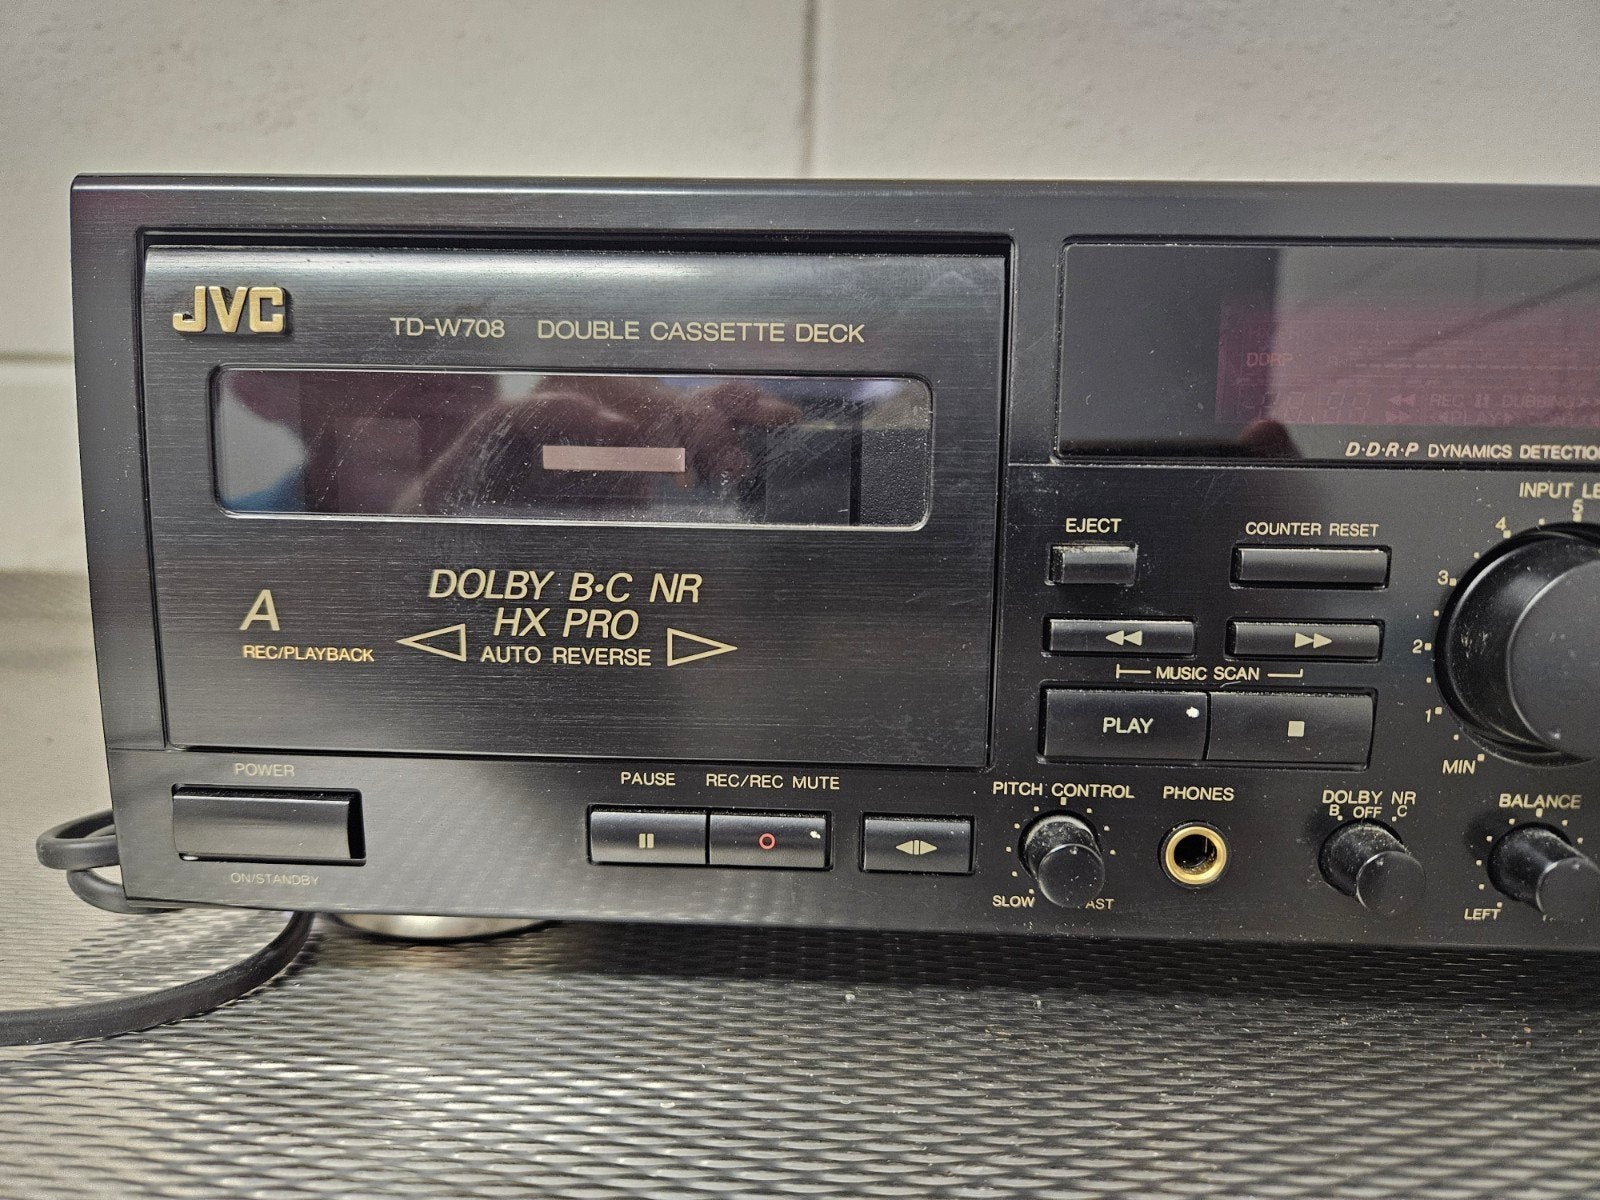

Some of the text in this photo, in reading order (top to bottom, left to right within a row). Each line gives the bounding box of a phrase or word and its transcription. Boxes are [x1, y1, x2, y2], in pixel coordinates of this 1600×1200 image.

[172, 286, 285, 334] JVC
[391, 317, 865, 344] TD-W708 DOUBLE CASSETTE DECK
[1428, 443, 1512, 459] DYNAMICS
[1519, 444, 1600, 460] DETECTIO
[1519, 482, 1574, 498] INPUT
[1572, 498, 1584, 514] 5
[1065, 518, 1122, 533] EJECT
[1245, 521, 1379, 538] COUNTER RESET
[1495, 516, 1507, 531] 4
[429, 569, 554, 600] DOLBY
[649, 573, 703, 603] NR
[1438, 570, 1449, 586] 3
[240, 589, 281, 632] A
[493, 607, 640, 639] HX PRO
[242, 644, 375, 662] REC/PLAYBACK
[1412, 639, 1423, 654] 2
[480, 646, 652, 667] AUTO REVERSE
[1155, 666, 1260, 681] MUSIC SCAN
[1424, 708, 1431, 723] 1
[1102, 717, 1154, 735] PLAY
[234, 763, 295, 778] POWER
[1442, 760, 1476, 775] MIN
[620, 772, 676, 787] PAUSE
[705, 773, 840, 790] REC/REC MUTE
[992, 781, 1135, 799] PITCH CONTROL
[1163, 786, 1235, 801] PHONES
[1322, 790, 1416, 806] DOLBY NR
[1498, 793, 1582, 810] BALANCE
[1329, 804, 1408, 819] B OFF C
[230, 872, 320, 887] ON/STANDBY
[992, 895, 1035, 908] SLOW
[1085, 898, 1115, 911] AST
[1464, 907, 1500, 921] LEFT
